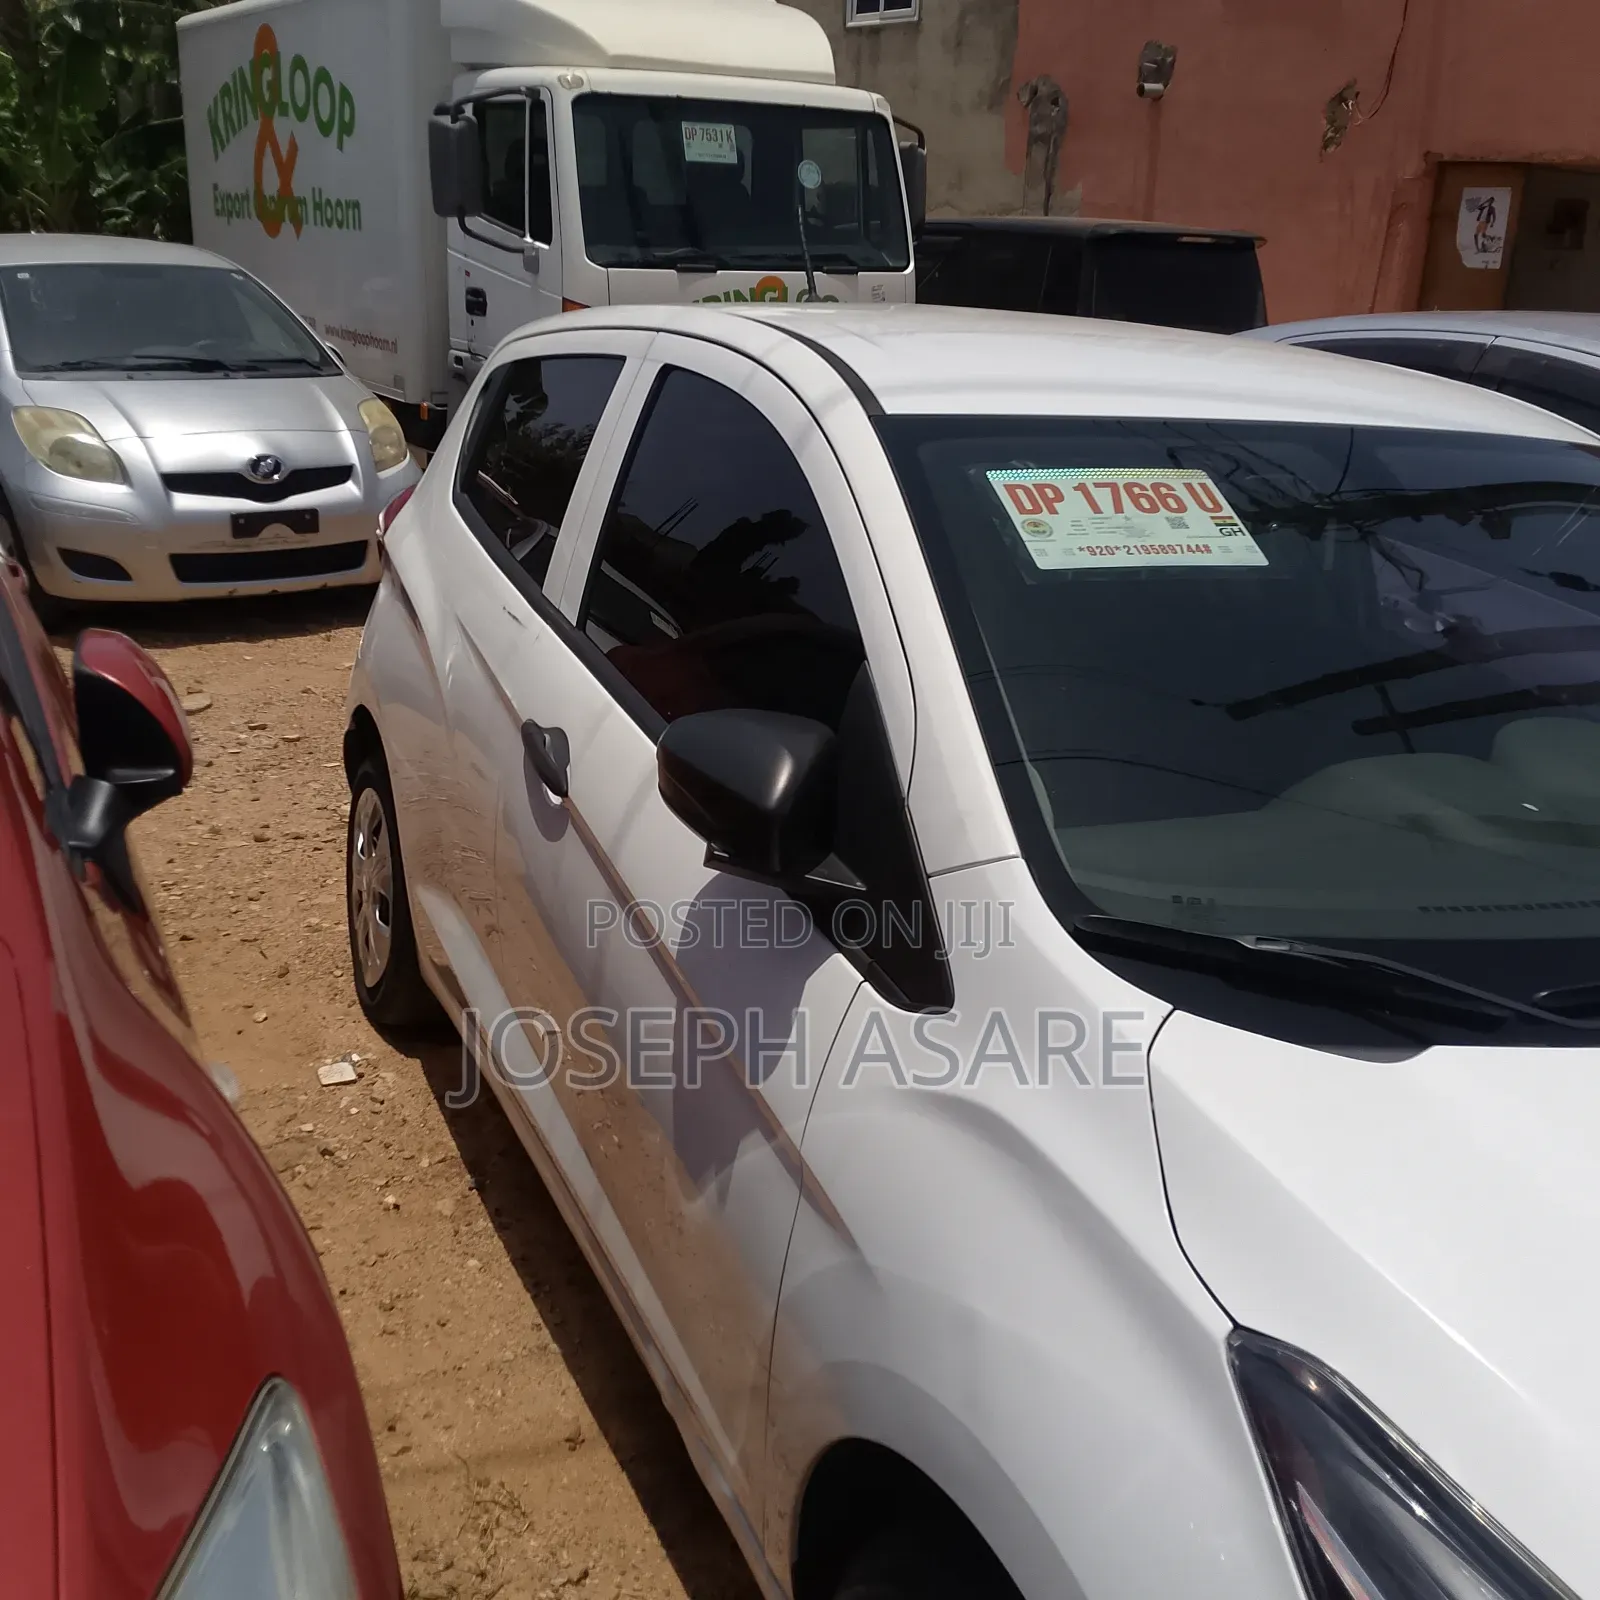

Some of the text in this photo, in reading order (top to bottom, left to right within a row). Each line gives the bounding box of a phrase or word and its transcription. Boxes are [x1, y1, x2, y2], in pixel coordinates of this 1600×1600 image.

[207, 51, 356, 162] KRINGLOOP
[684, 126, 733, 144] DP 7531 K
[212, 182, 251, 226] Export
[311, 186, 362, 231] Hoorn
[1003, 481, 1224, 516] DP 1766 U
[1218, 526, 1247, 537] GH
